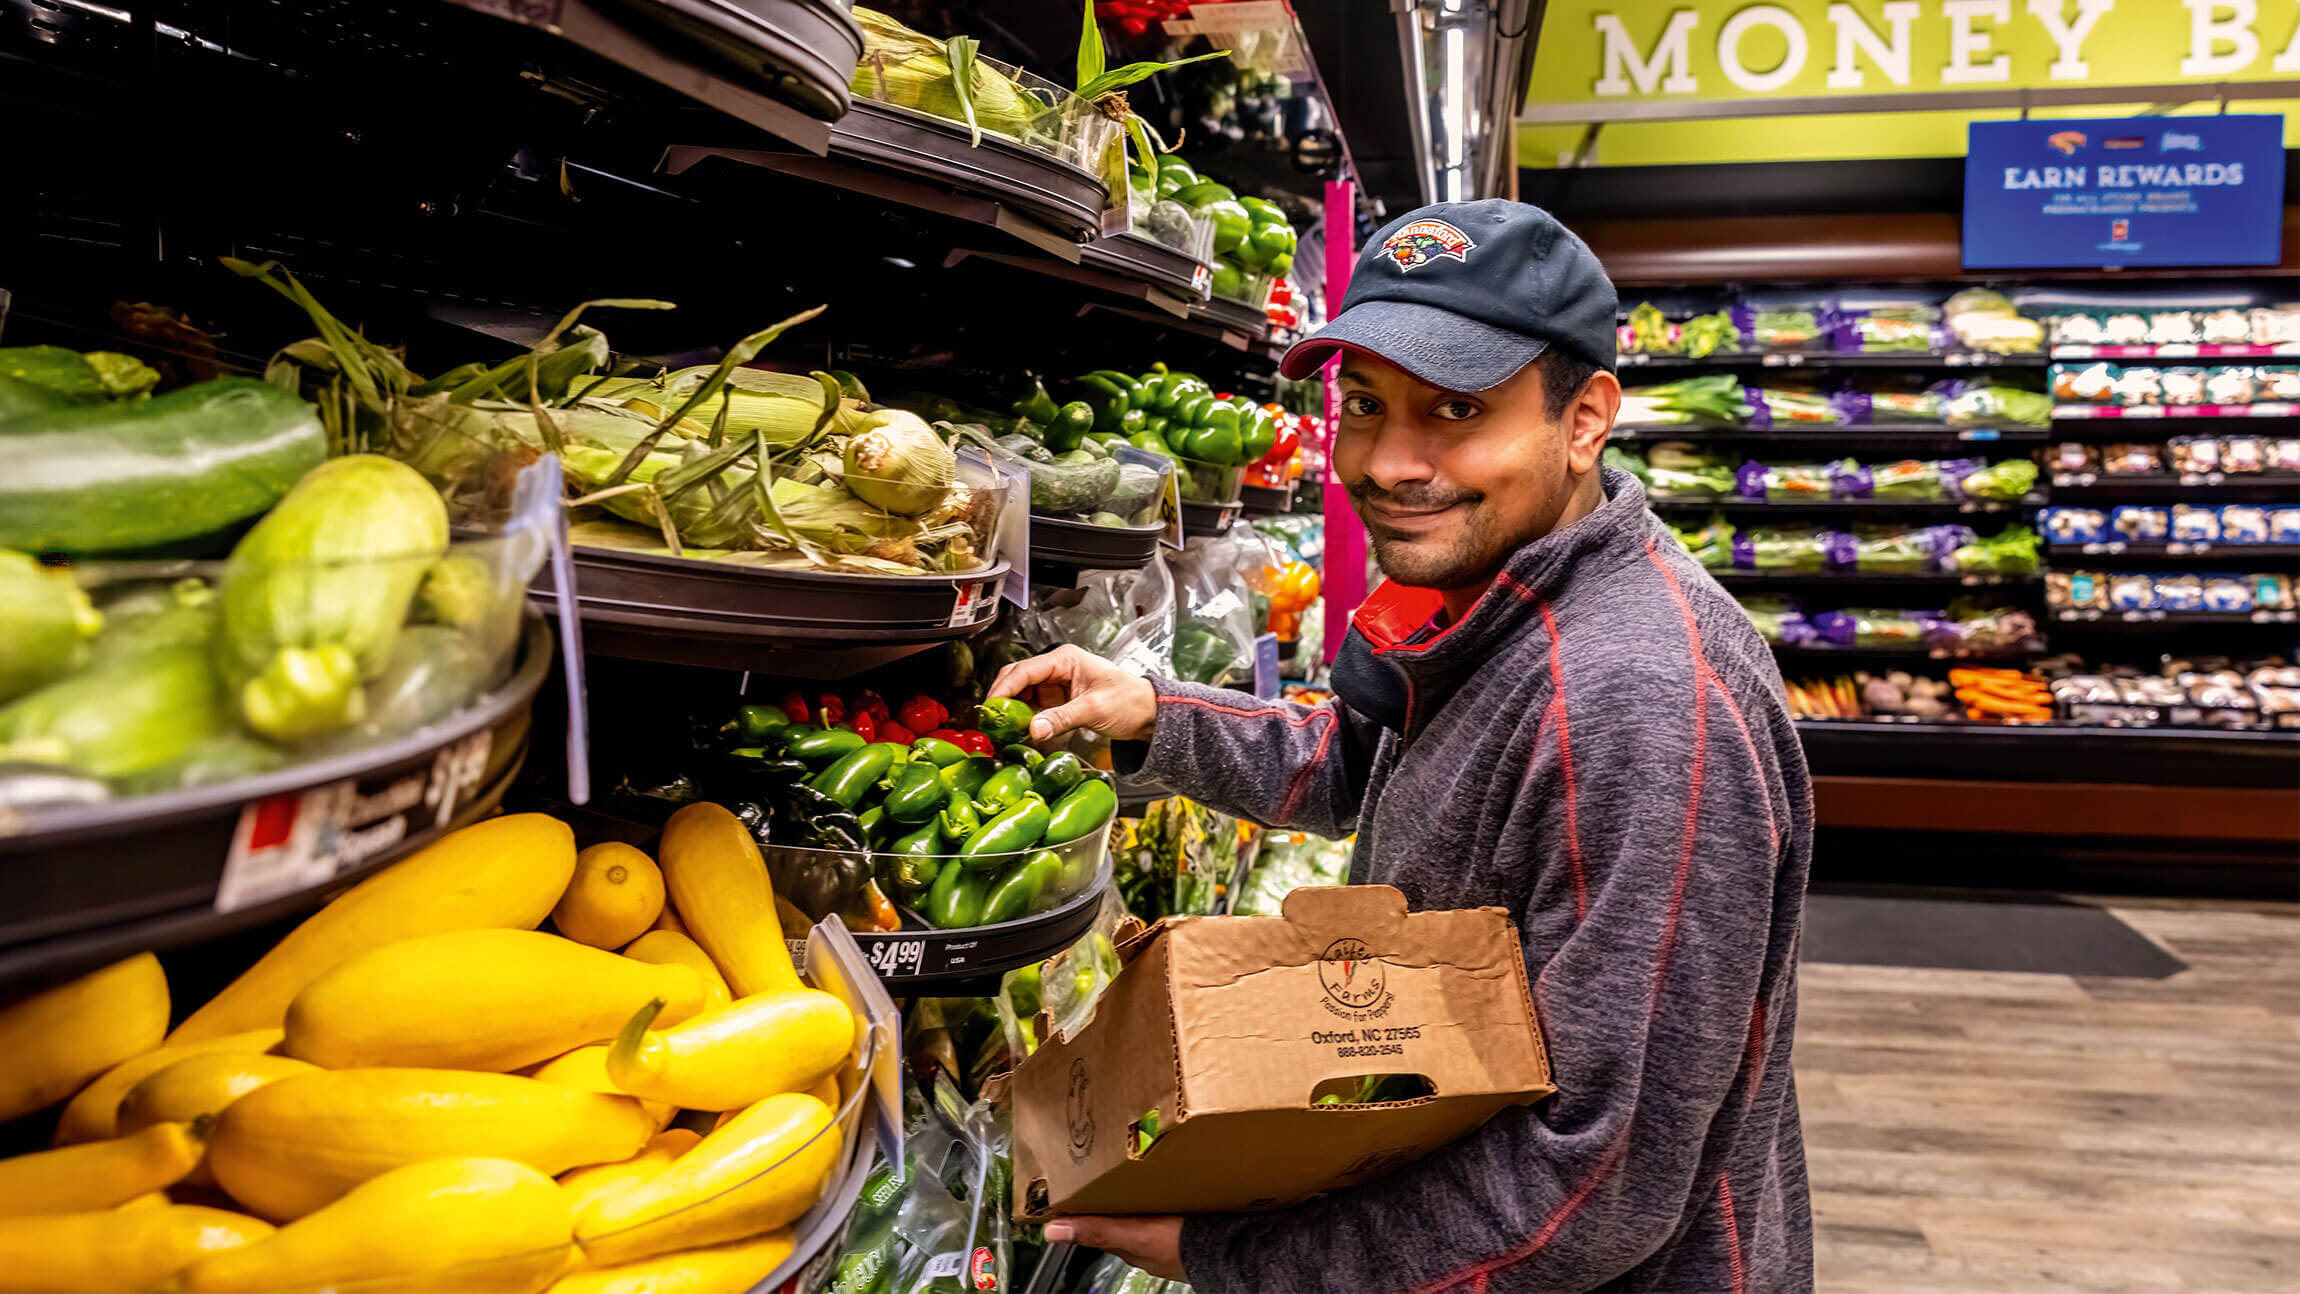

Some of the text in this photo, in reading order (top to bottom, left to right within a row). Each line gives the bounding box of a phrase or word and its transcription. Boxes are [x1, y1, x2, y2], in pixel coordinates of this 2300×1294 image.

[1595, 0, 2112, 95] MONEY
[2003, 163, 2245, 190] EARN REWARDS
[1329, 978, 1380, 1003] Farms
[1311, 1026, 1421, 1044] Oxford, NC 27565
[1337, 1044, 1403, 1058] 888-820-2545
